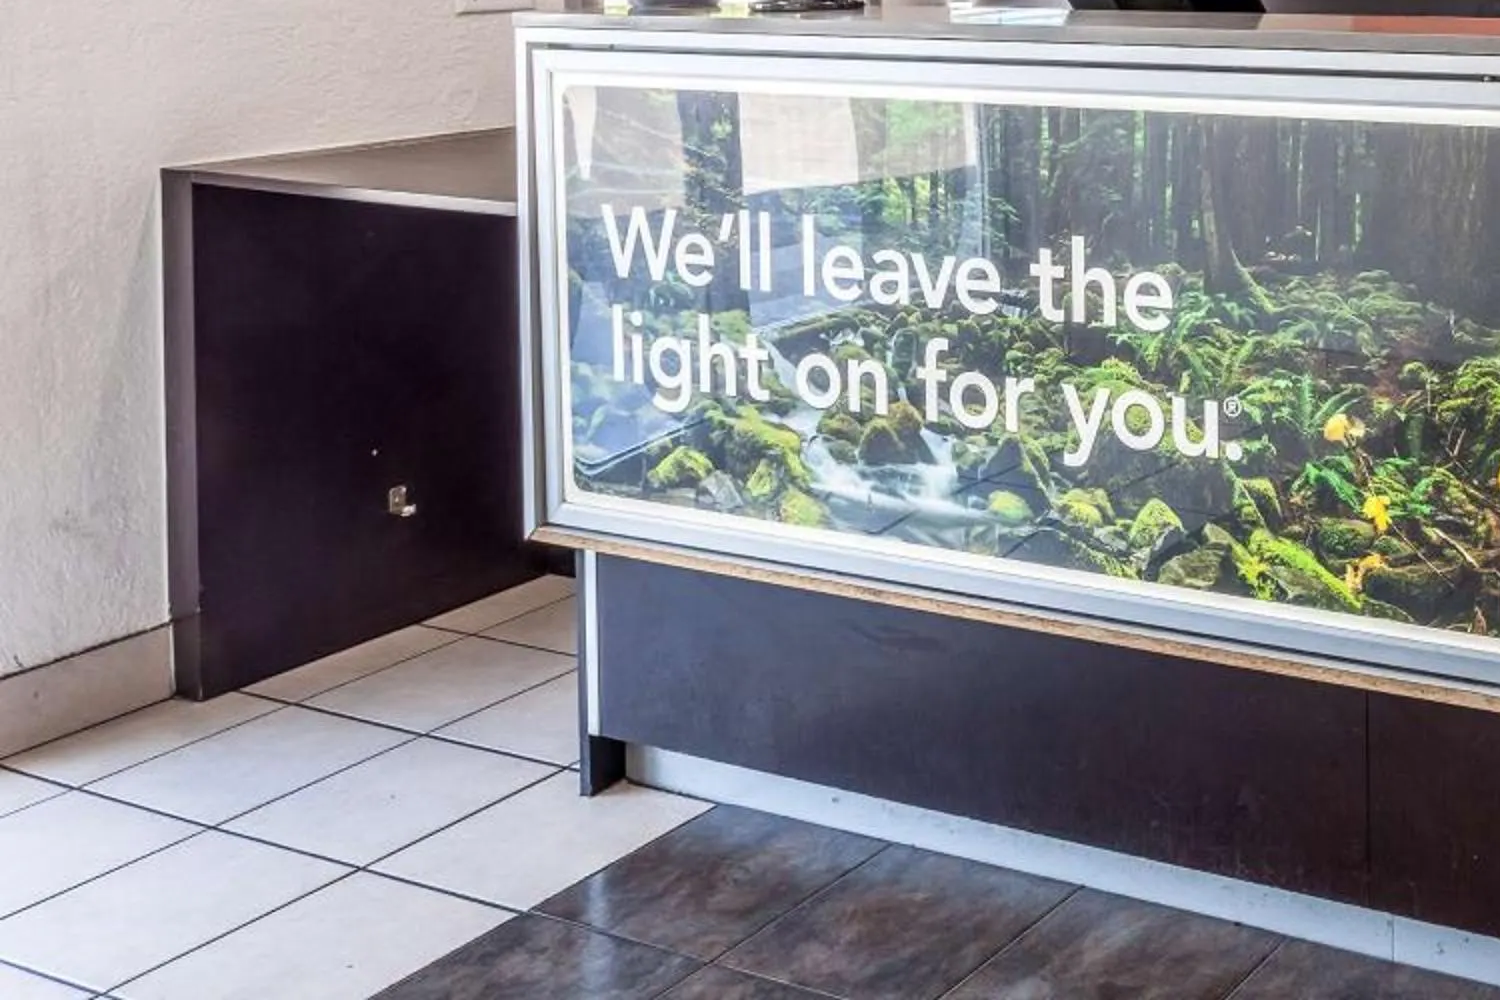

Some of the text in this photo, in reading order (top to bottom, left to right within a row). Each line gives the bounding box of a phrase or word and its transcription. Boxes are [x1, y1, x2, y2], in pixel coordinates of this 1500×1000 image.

[601, 203, 1174, 333] We'll leave the
[611, 303, 770, 414] light
[795, 352, 889, 416] on
[915, 337, 1034, 433] for
